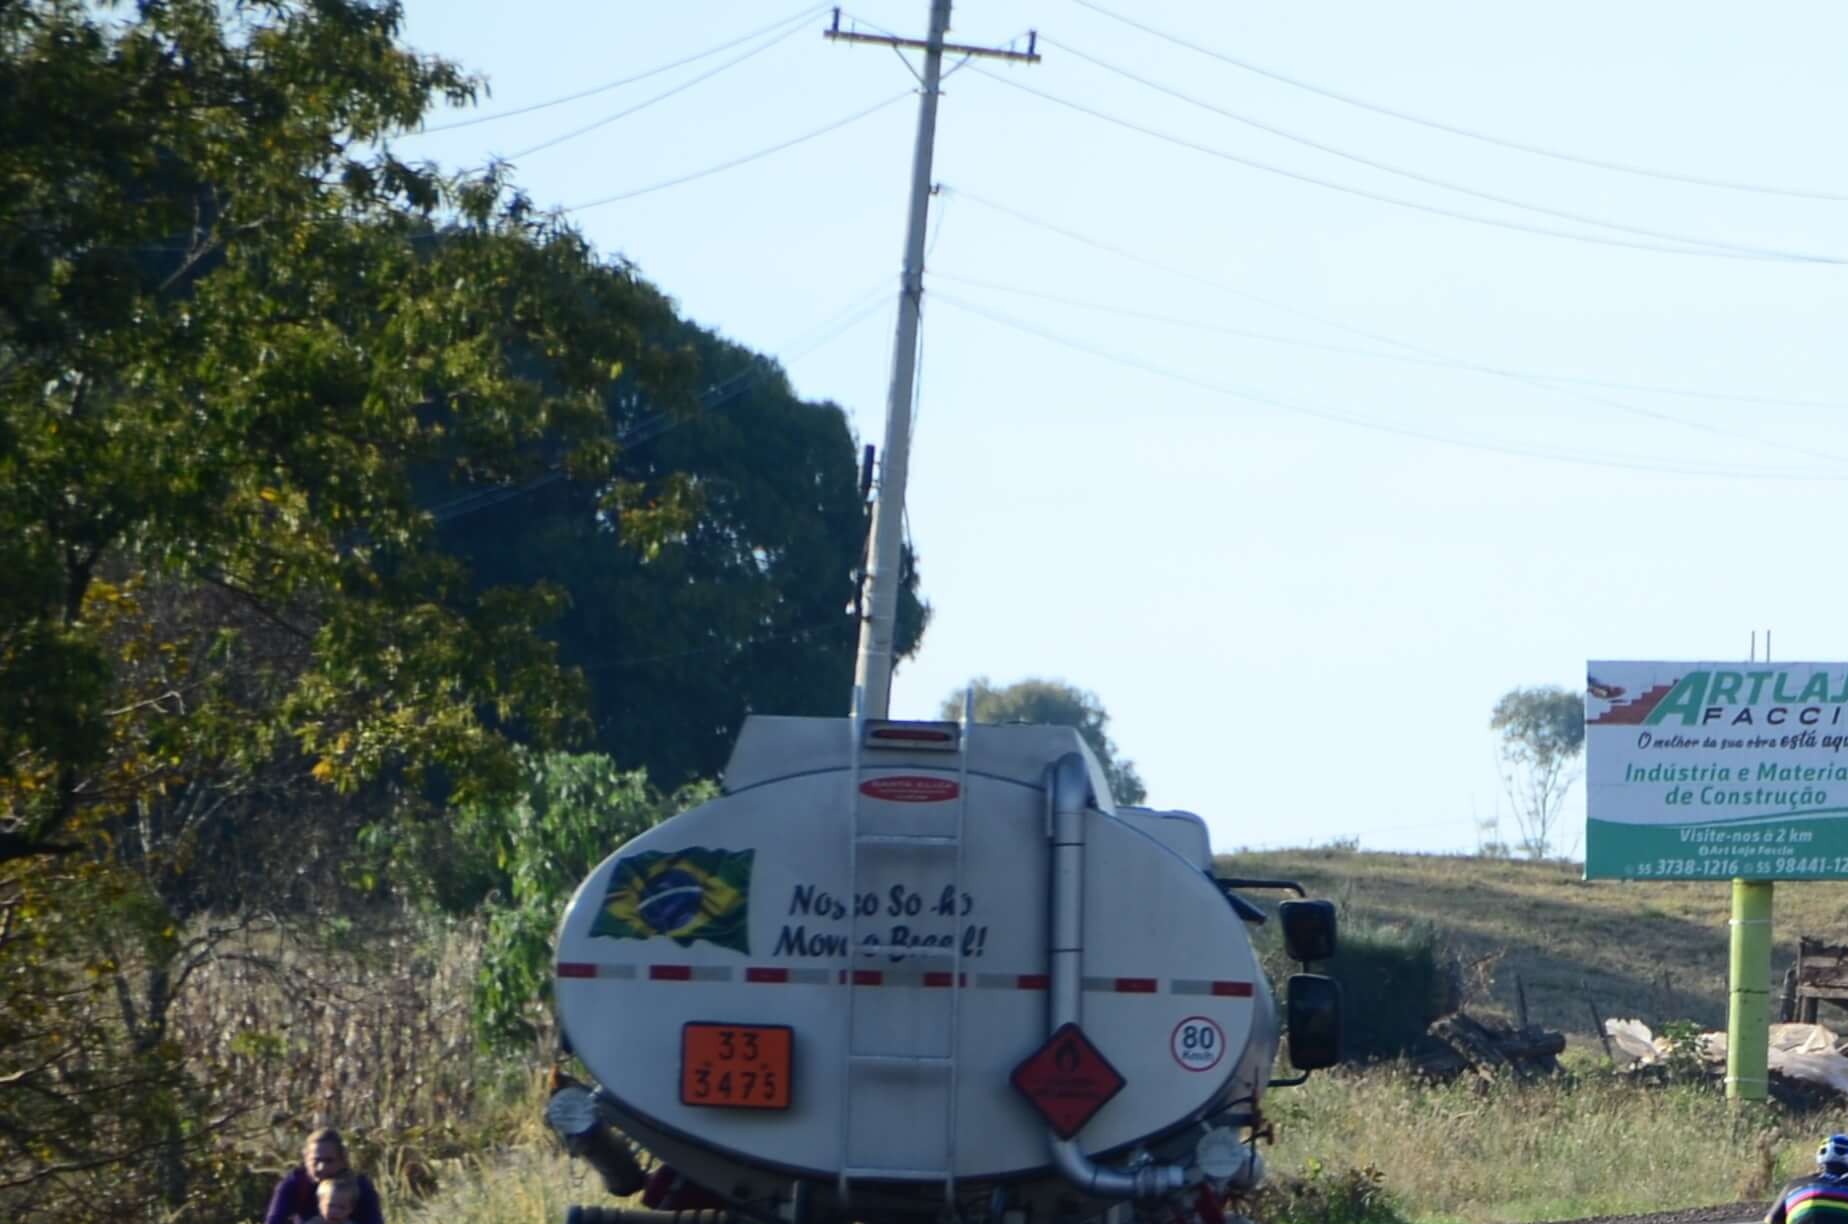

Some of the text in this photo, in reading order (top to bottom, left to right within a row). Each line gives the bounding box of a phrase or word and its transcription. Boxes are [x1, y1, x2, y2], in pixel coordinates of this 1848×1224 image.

[1637, 731, 1651, 749] O
[1654, 736, 1699, 749] melhor
[1780, 729, 1818, 750] está
[1625, 762, 1730, 782] Indústria
[1737, 767, 1750, 782] e
[1664, 786, 1828, 809] de Construção
[1680, 828, 1760, 843] Visite-nos
[1775, 829, 1786, 843] 2
[1788, 828, 1812, 843] km
[1655, 859, 1739, 876] 3738-1216
[719, 1031, 759, 1060] 33
[1183, 1025, 1214, 1050] 80
[694, 1069, 776, 1100] 3475
